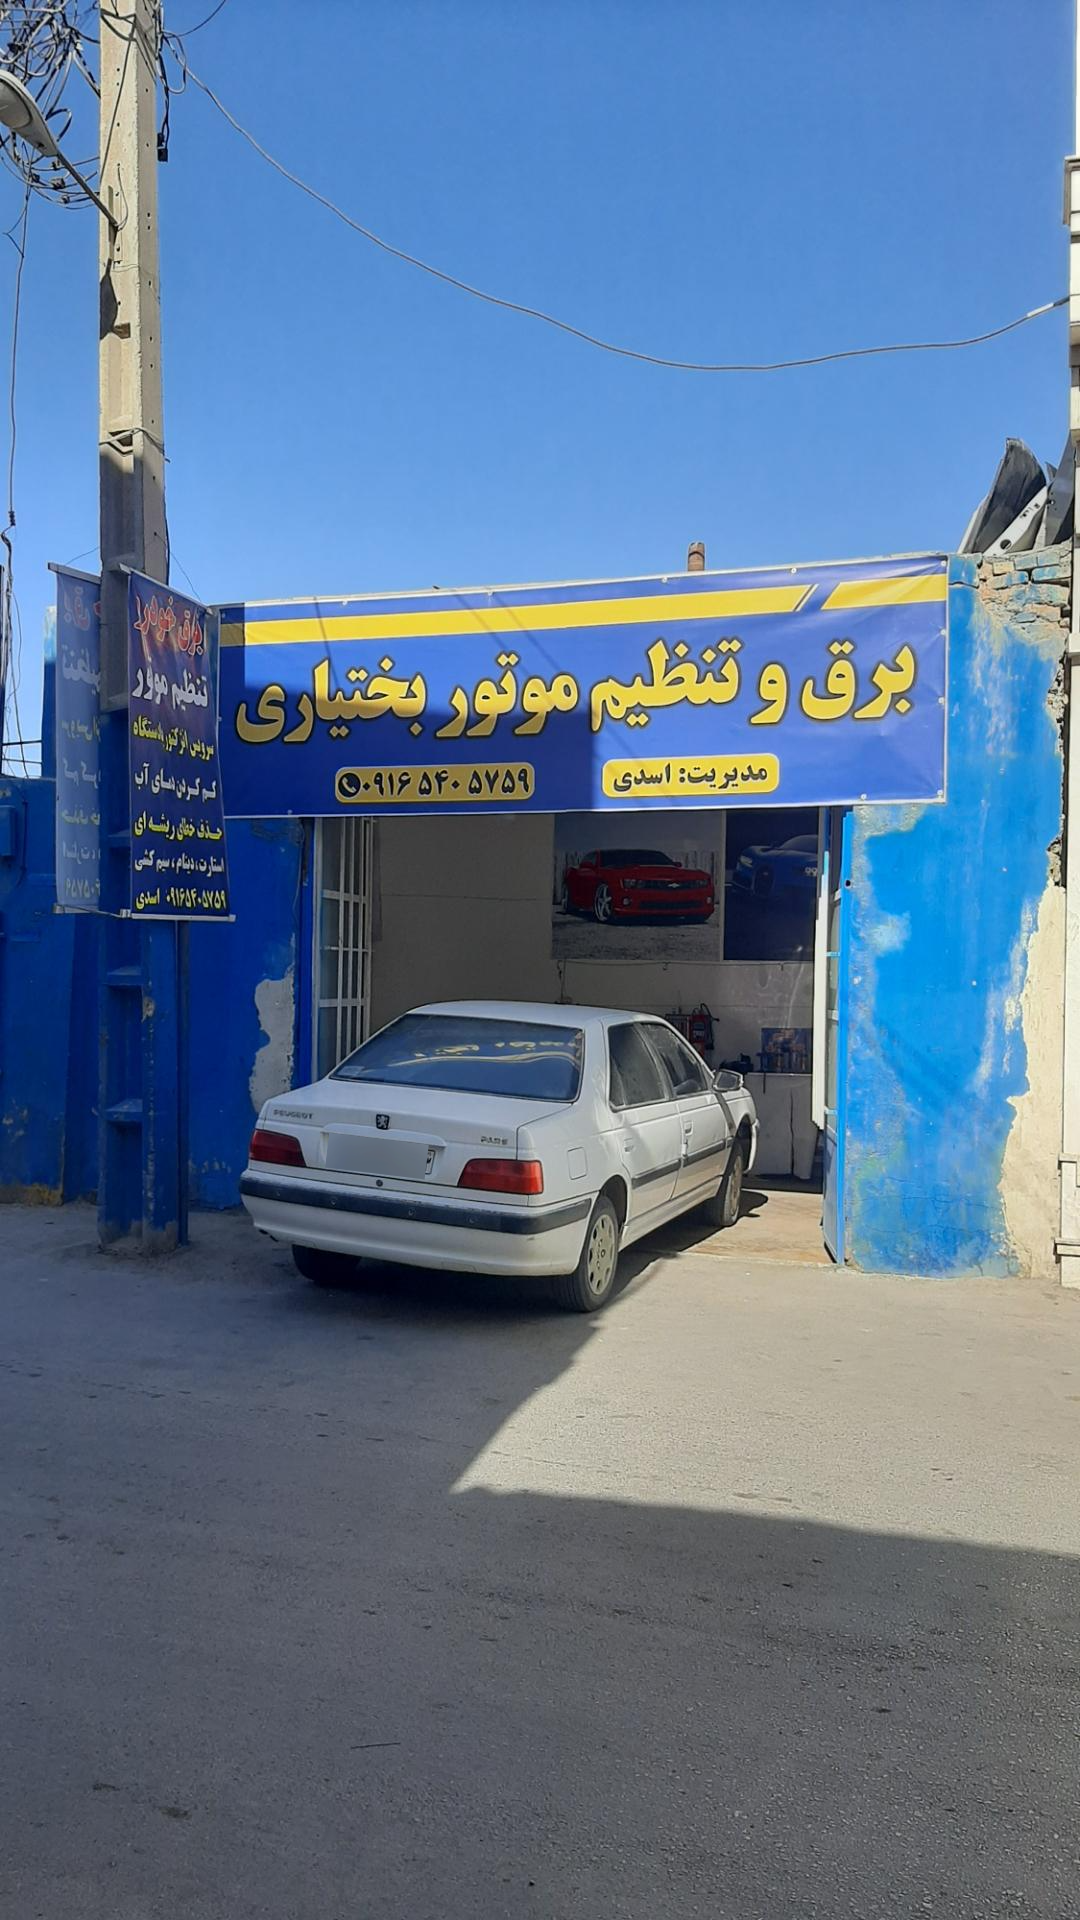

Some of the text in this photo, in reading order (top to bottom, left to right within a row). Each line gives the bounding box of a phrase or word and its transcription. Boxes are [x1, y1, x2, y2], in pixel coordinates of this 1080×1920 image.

[132, 656, 208, 711] تنظیم موتور
[236, 638, 916, 743] برق و تنظیم موتور بختیاری
[190, 740, 214, 760] سرویس
[135, 762, 216, 802] کم کردن دمای آب
[362, 767, 530, 796] ۰۹۱۶ ۵۴۰ ۵۷۵۹
[613, 763, 768, 791] مدیریت: اسدی
[135, 811, 222, 840] حذف خطای ریشه ای
[135, 849, 155, 871] کشی
[156, 858, 170, 872] سیم
[136, 887, 160, 910] اسدی
[273, 1108, 314, 1120] PEUGEOT
